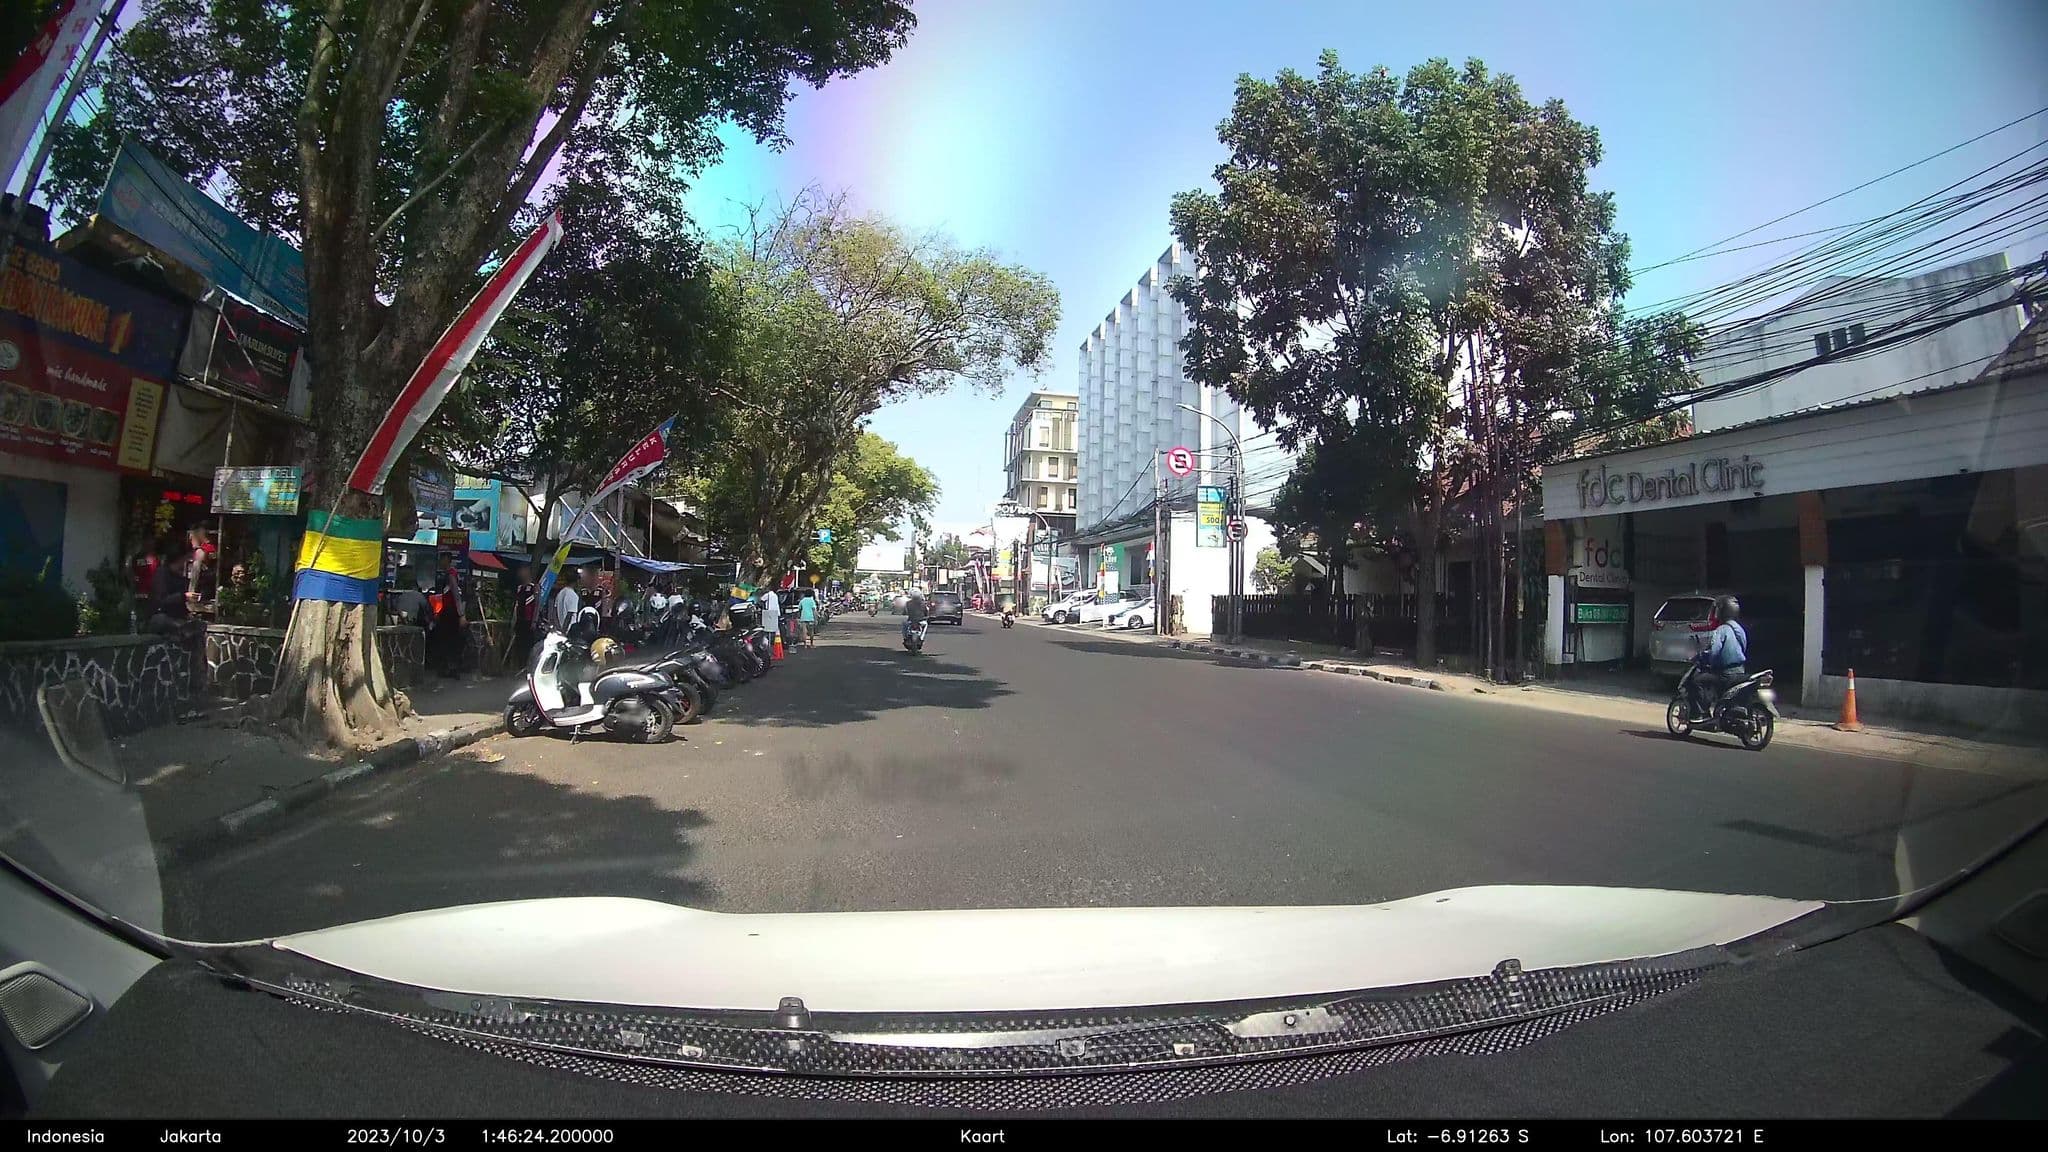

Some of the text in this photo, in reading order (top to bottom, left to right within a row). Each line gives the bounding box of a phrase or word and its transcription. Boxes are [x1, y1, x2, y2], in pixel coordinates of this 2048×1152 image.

[64, 367, 108, 392] handmade
[1577, 455, 1766, 509] fdc Dental Clinic
[1584, 537, 1621, 568] fdc
[1579, 571, 1606, 583] Dental
